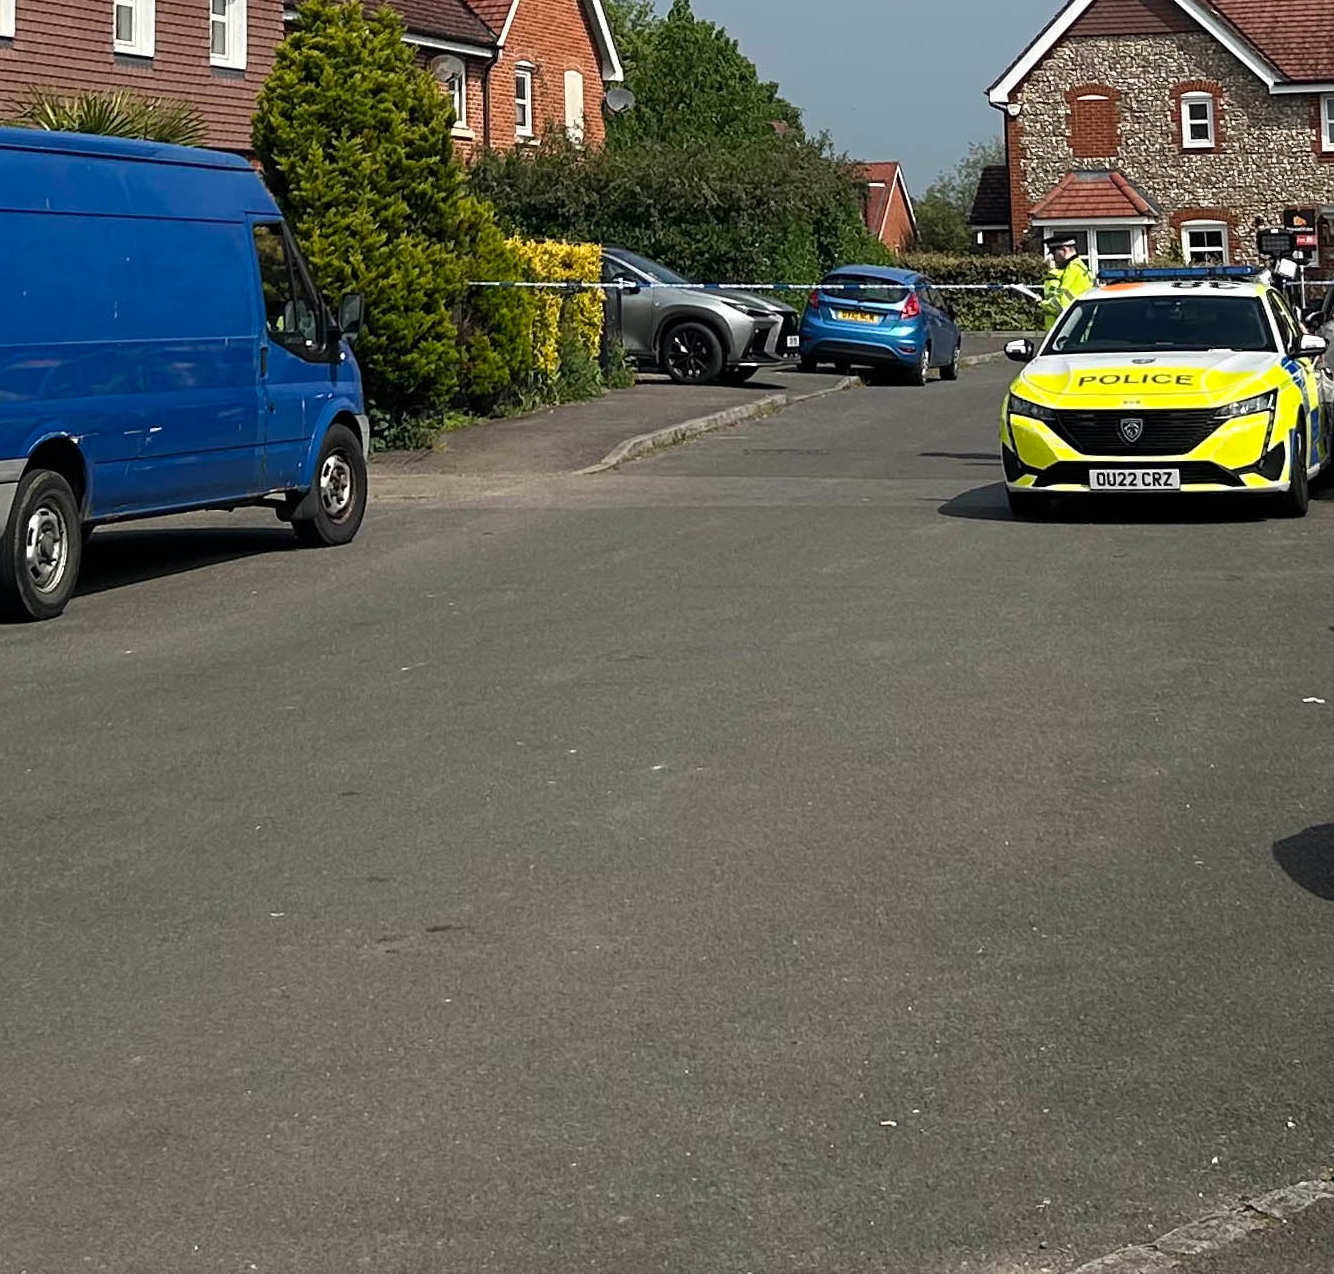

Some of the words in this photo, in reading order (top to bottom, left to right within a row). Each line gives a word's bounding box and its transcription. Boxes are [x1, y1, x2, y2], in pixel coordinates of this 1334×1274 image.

[1078, 373, 1194, 387] POLICE
[1096, 471, 1138, 487] OU22
[1141, 471, 1173, 487] CRZ
